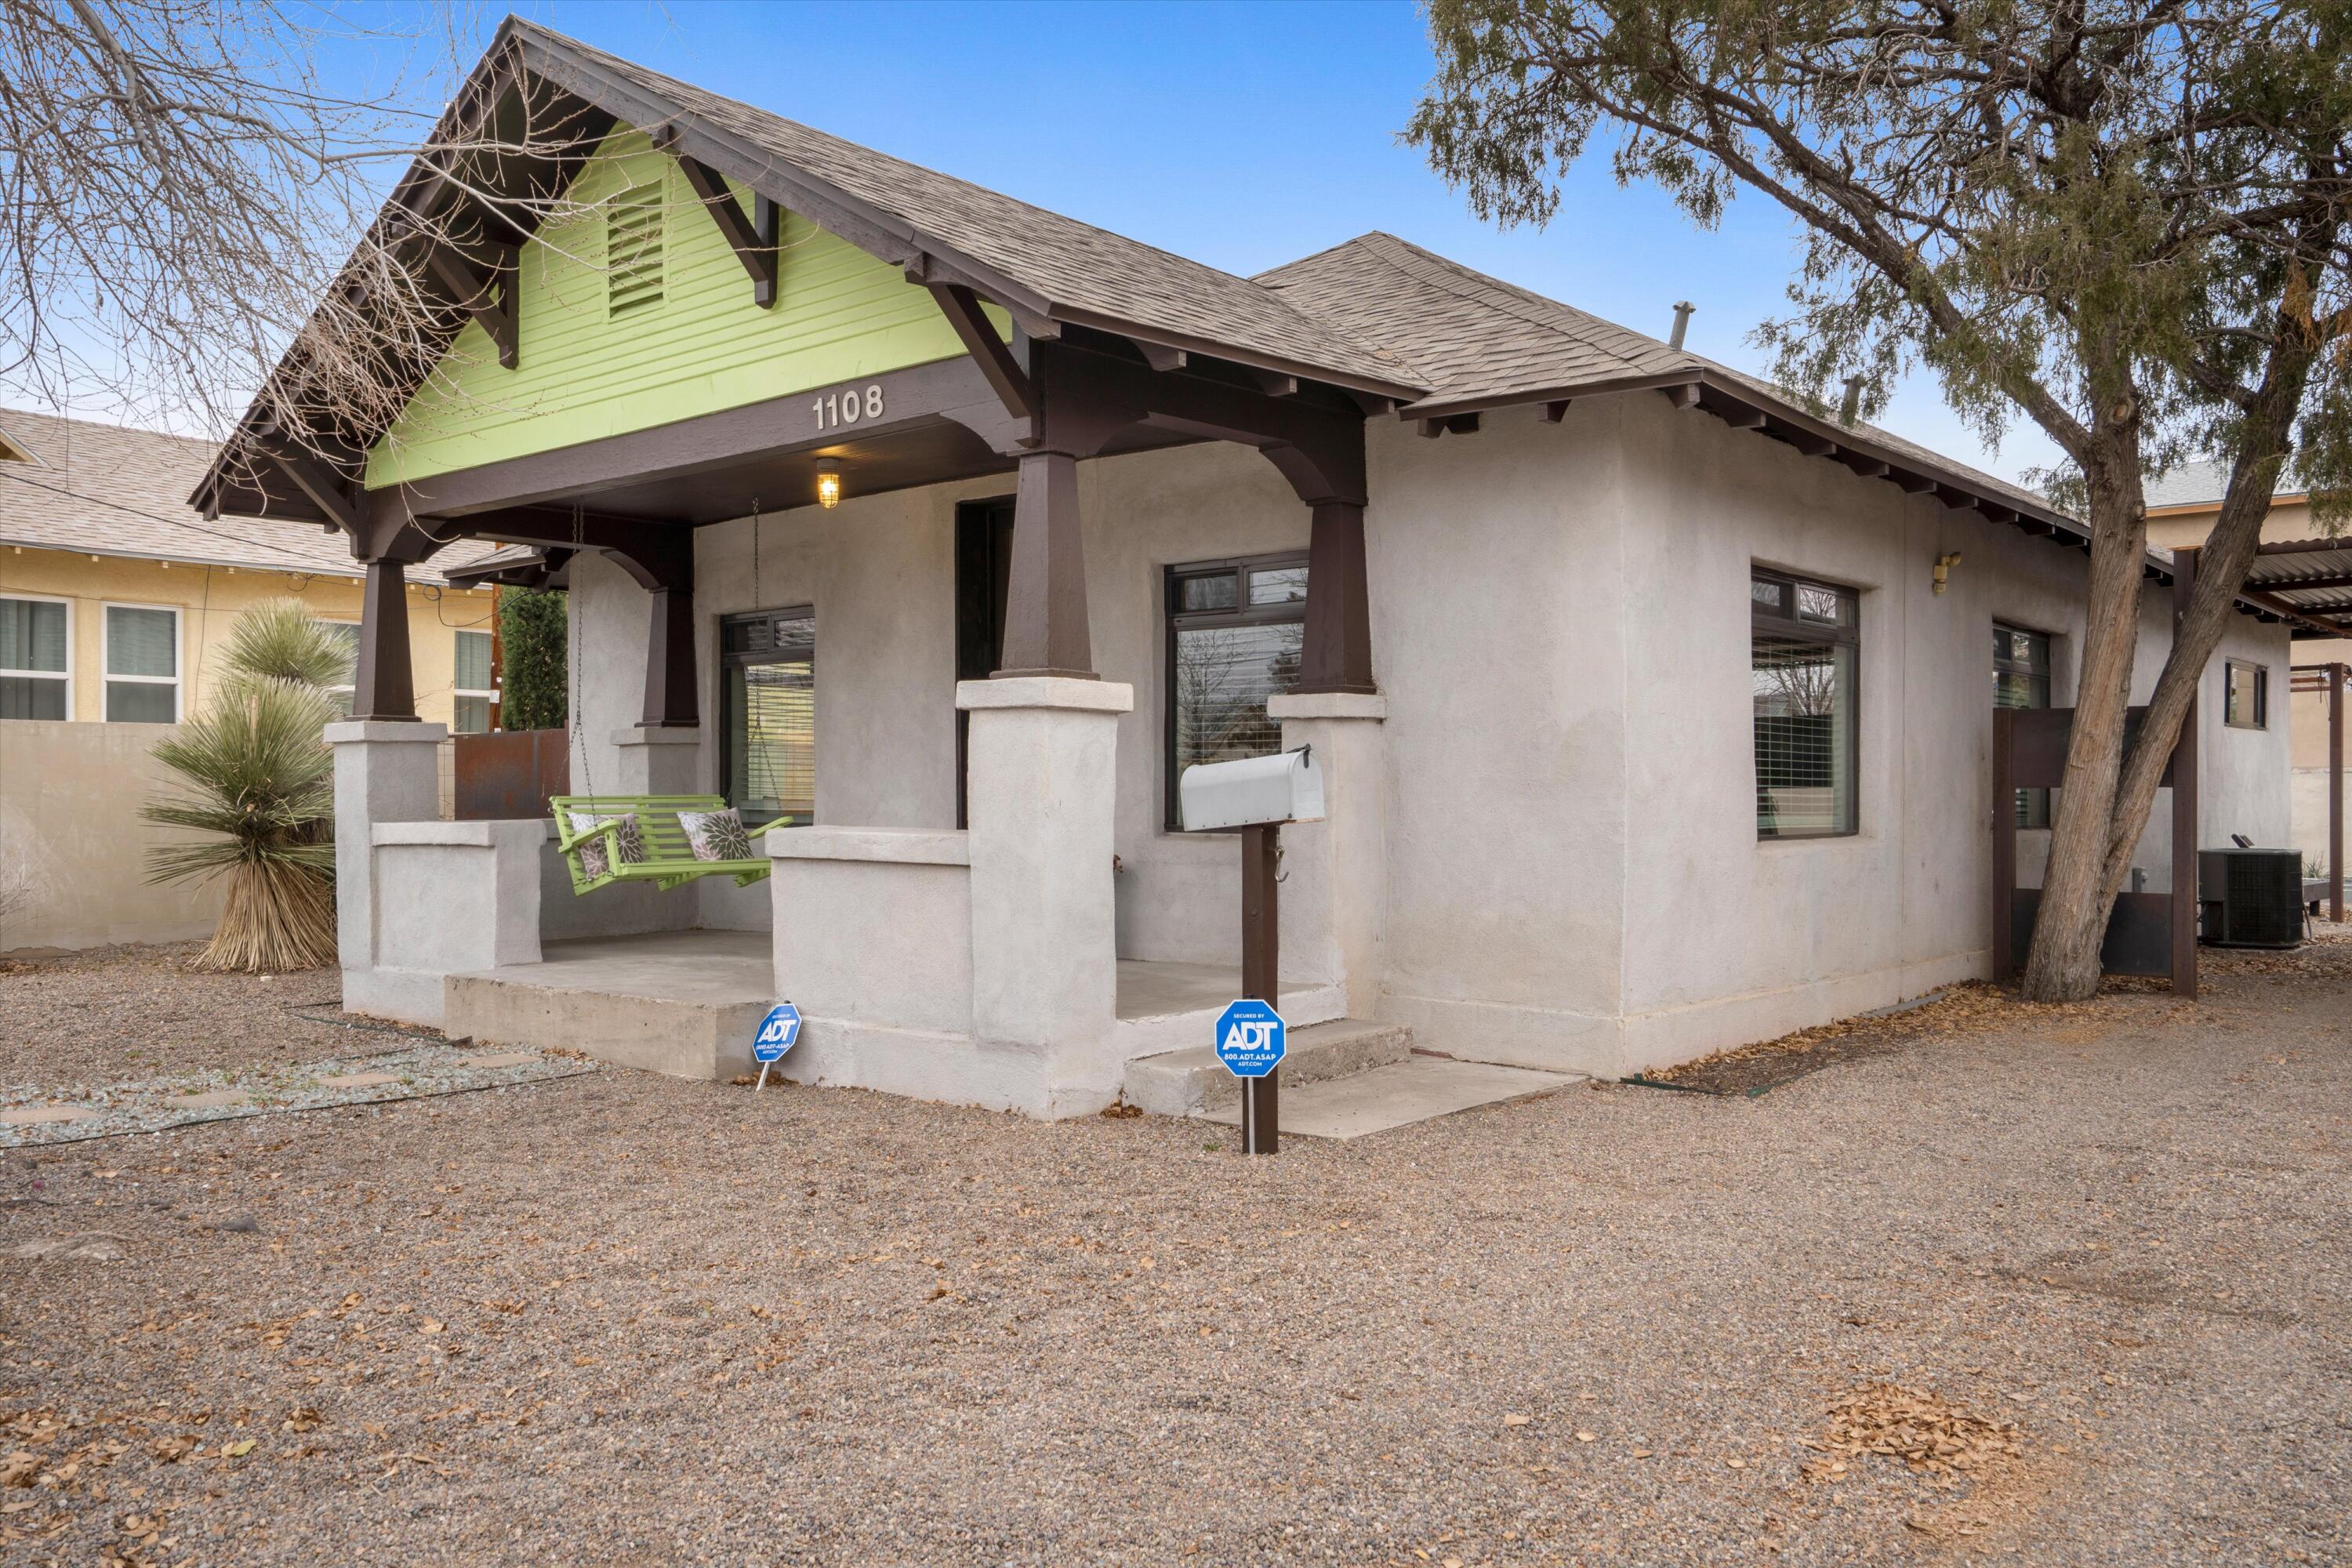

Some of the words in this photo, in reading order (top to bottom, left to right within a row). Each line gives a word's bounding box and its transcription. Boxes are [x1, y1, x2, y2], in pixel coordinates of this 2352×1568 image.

[813, 385, 884, 430] 1108
[757, 1019, 797, 1043] ADT
[1222, 1022, 1277, 1050] ADT
